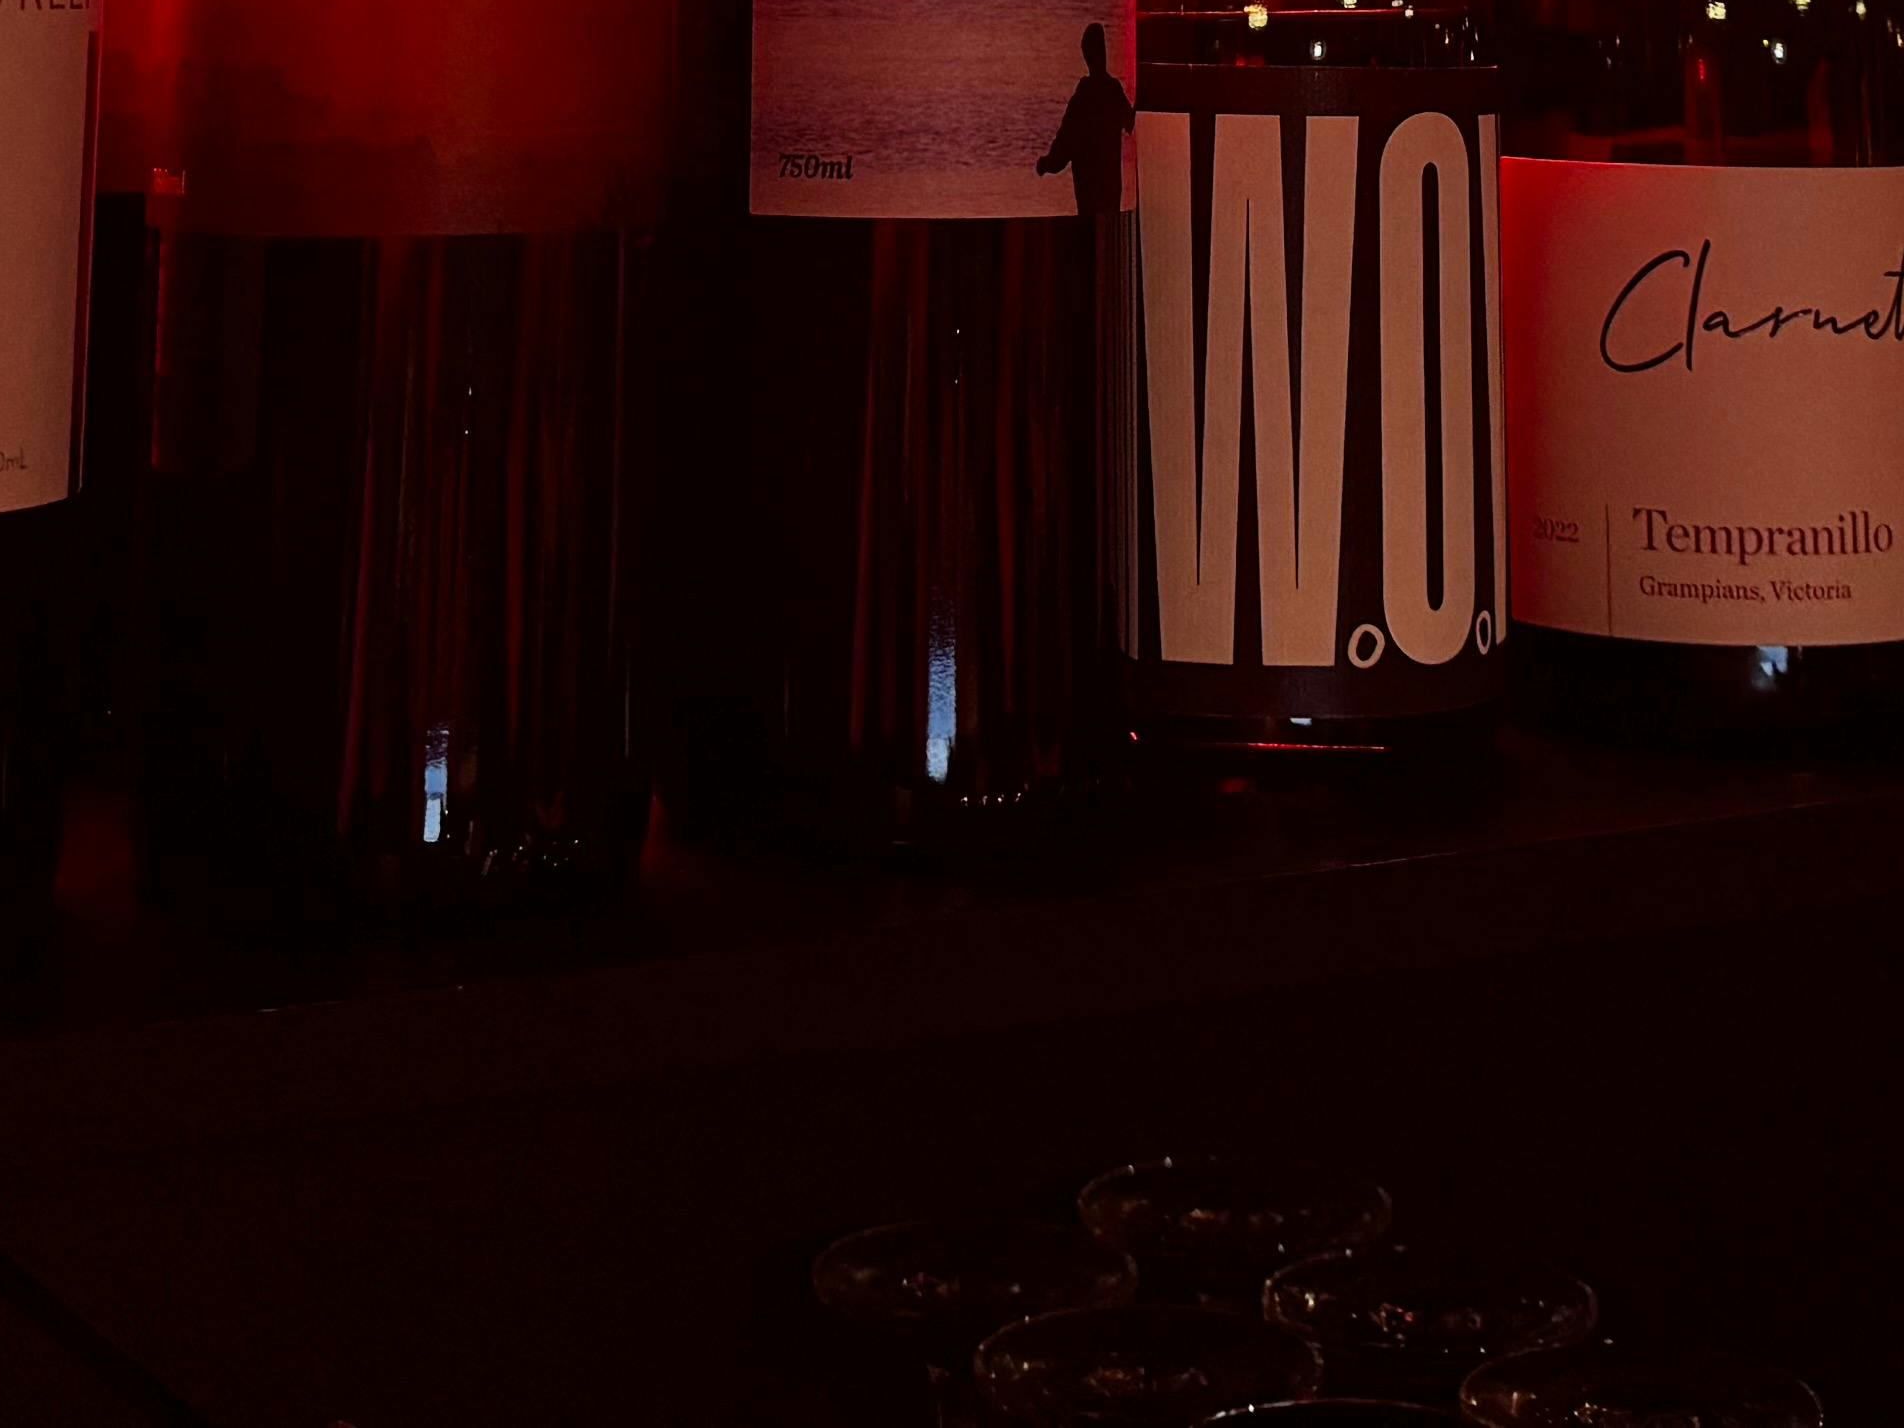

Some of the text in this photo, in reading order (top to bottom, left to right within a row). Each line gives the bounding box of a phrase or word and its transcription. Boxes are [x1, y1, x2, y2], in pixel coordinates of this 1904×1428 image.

[778, 152, 853, 180] 750ml
[1632, 506, 1894, 566] Tempranillo
[1638, 575, 1853, 604] Grampians, Victoria
